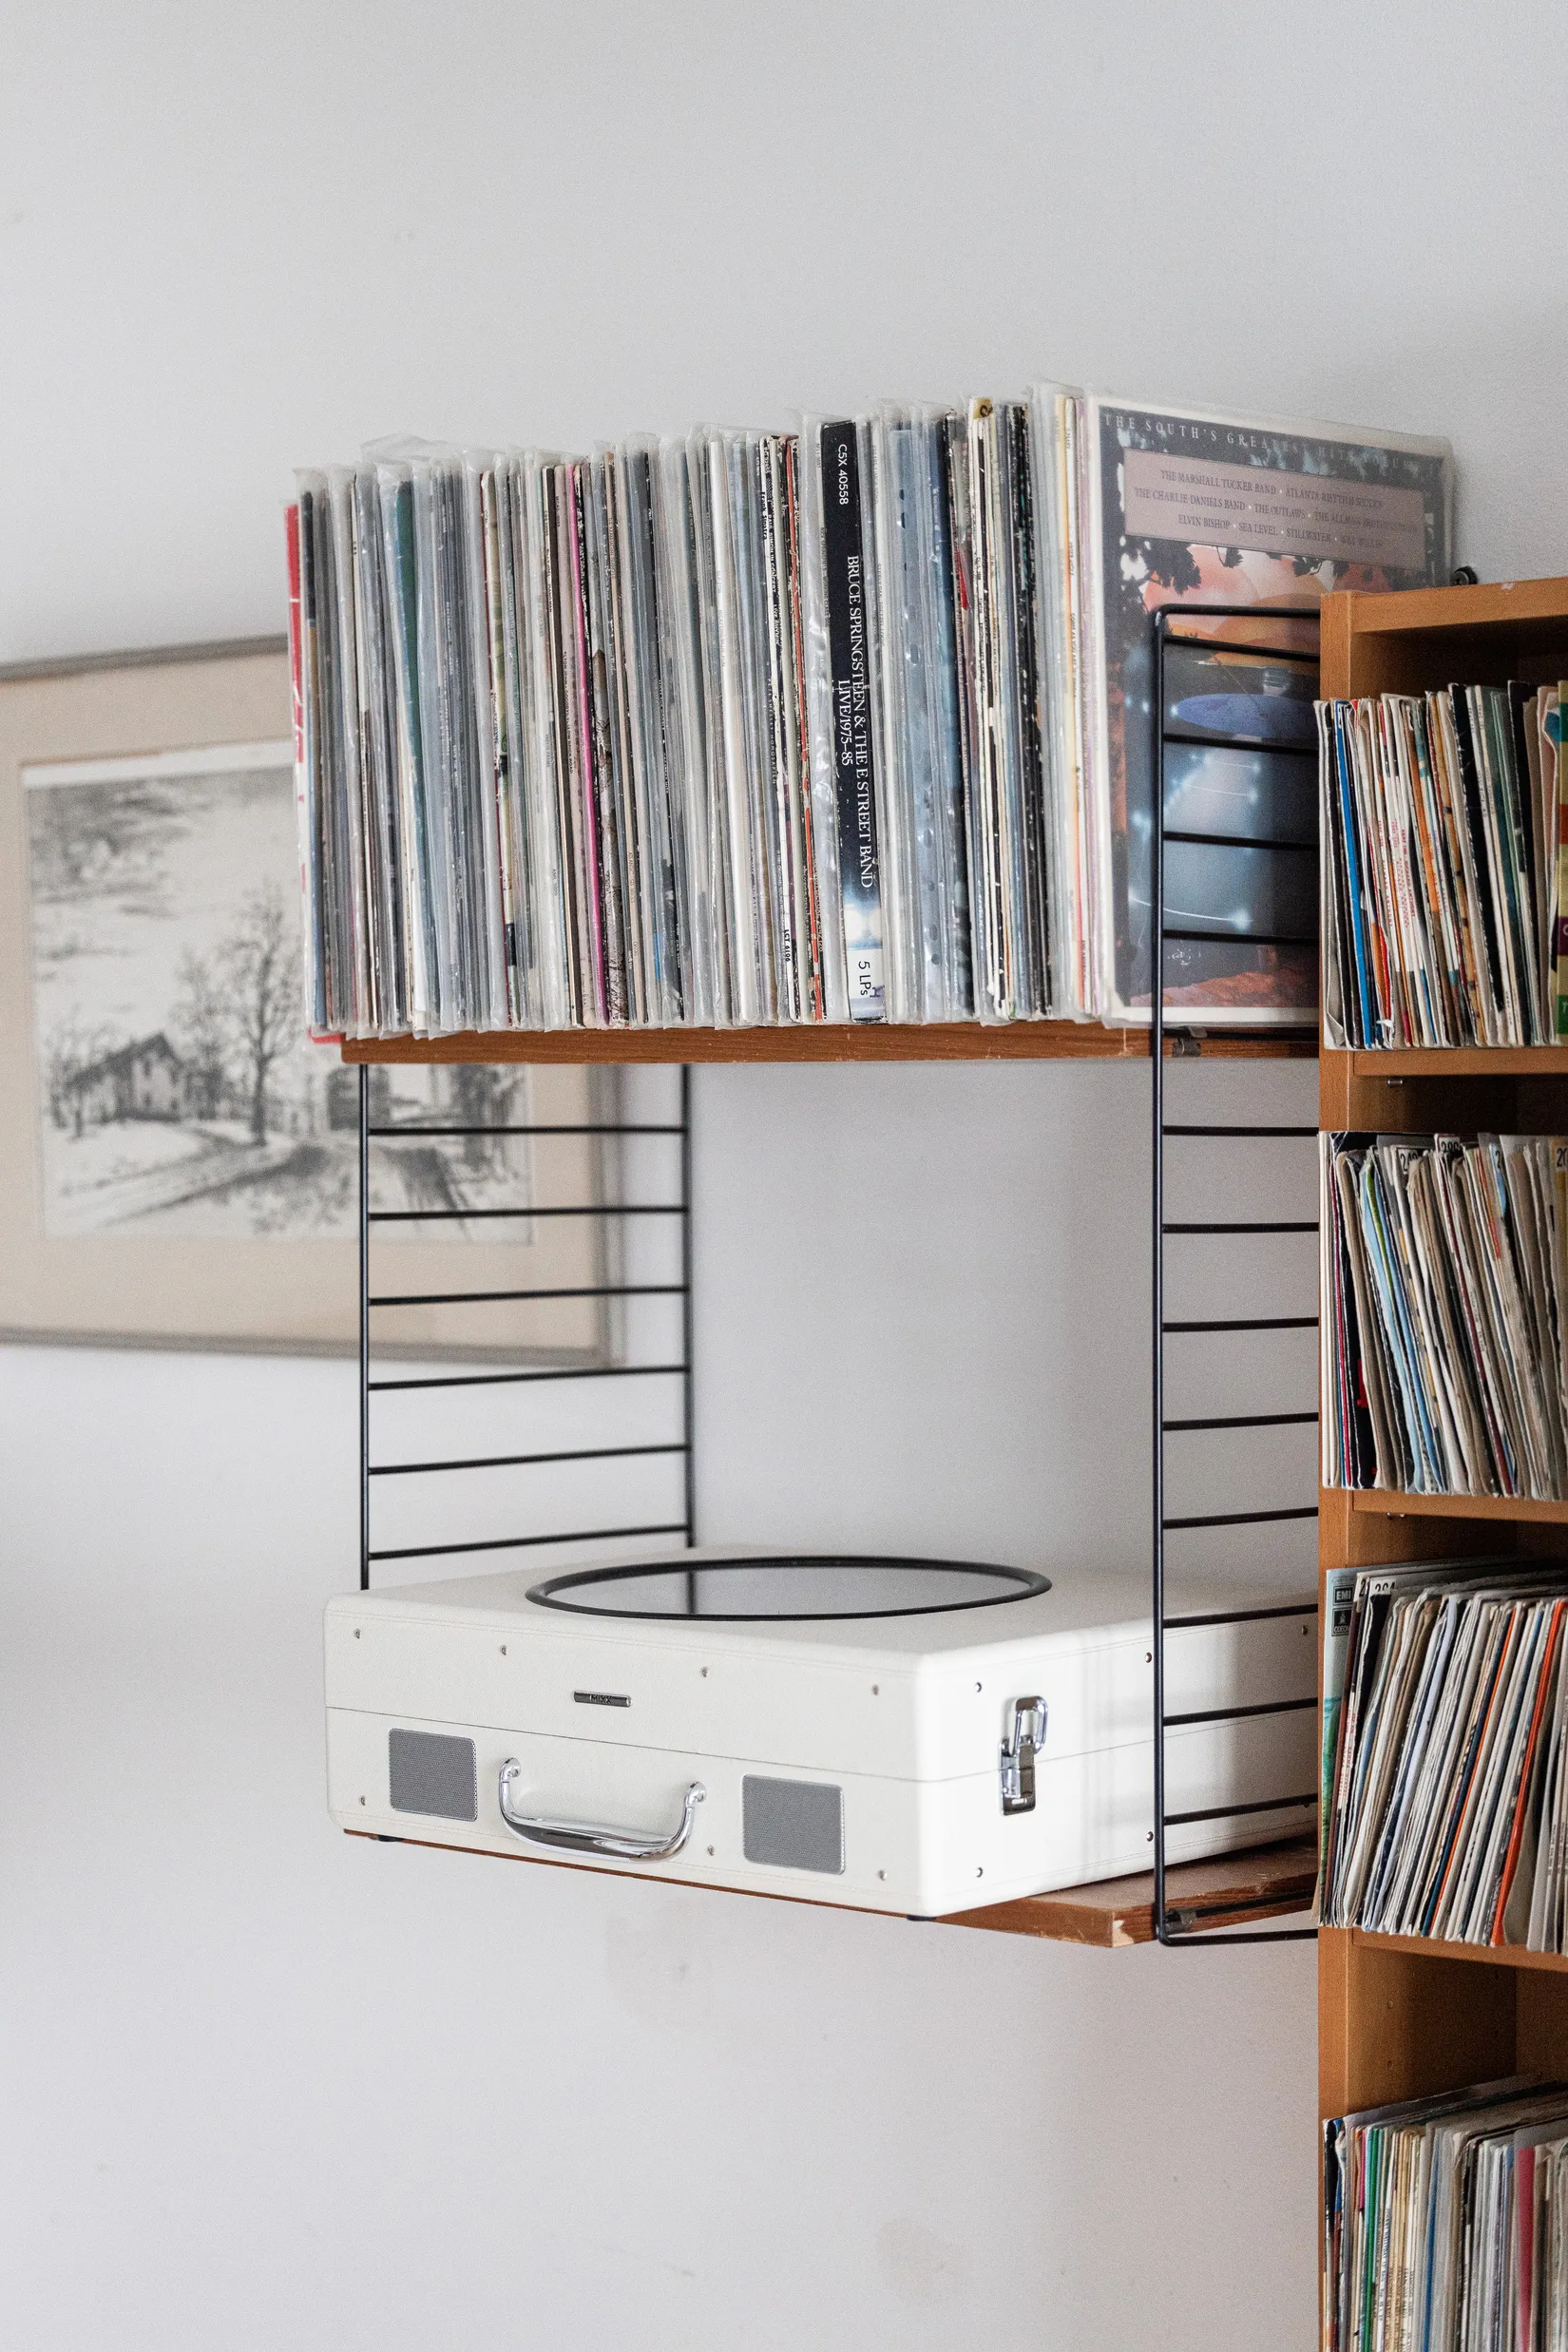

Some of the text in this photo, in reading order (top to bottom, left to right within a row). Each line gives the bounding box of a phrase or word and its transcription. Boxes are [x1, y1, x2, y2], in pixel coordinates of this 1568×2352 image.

[1104, 413, 1136, 430] THE
[1145, 419, 1217, 442] SOUTH'S
[838, 444, 850, 505] C5X 40558
[1160, 469, 1177, 482] THE
[1177, 473, 1221, 488] MARSHALL
[1221, 478, 1253, 492] TUCKER
[1254, 483, 1277, 495] BAND
[1285, 488, 1319, 501] ATLANTA
[1134, 487, 1151, 499] THE
[1152, 489, 1188, 504] CHARLIE
[1190, 494, 1223, 507] DANIELS
[1224, 499, 1246, 511] BAND
[1254, 502, 1271, 514] THE
[1271, 505, 1306, 519] OUTLAWS
[1178, 514, 1202, 526] ELVIN
[1203, 518, 1231, 530] BISHOP
[1238, 523, 1252, 533] SEA
[1253, 525, 1278, 536] LEVEL
[847, 555, 873, 889] BRUCE SPRINGSTEEN & THE E STREET BAND
[859, 961, 871, 996] 5 LPs
[1336, 1589, 1351, 1601] EMI
[590, 1694, 612, 1705] MIXX
